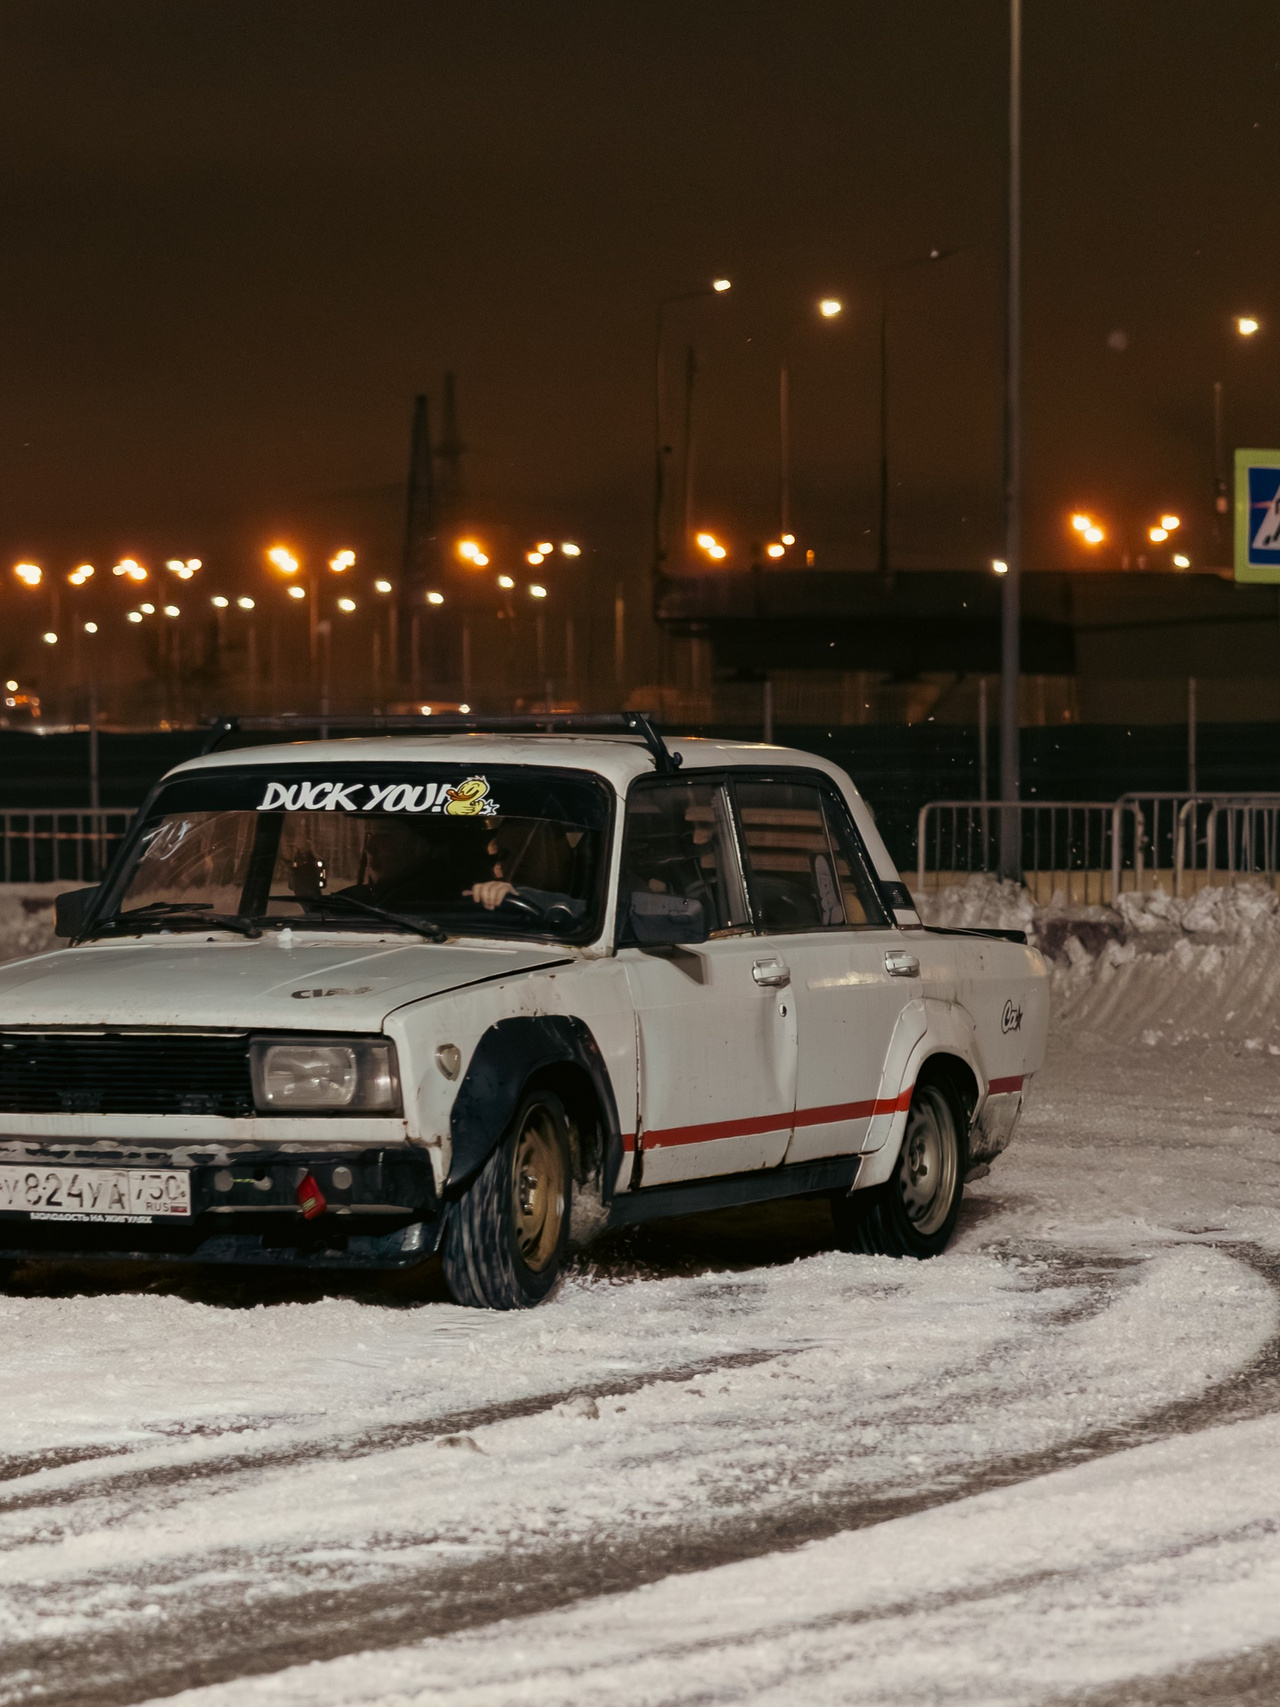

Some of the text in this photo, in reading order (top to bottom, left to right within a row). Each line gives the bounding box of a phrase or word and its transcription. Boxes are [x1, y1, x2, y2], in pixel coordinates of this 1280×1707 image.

[257, 782, 451, 812] DUCK YOU!
[146, 1202, 169, 1212] RUS
